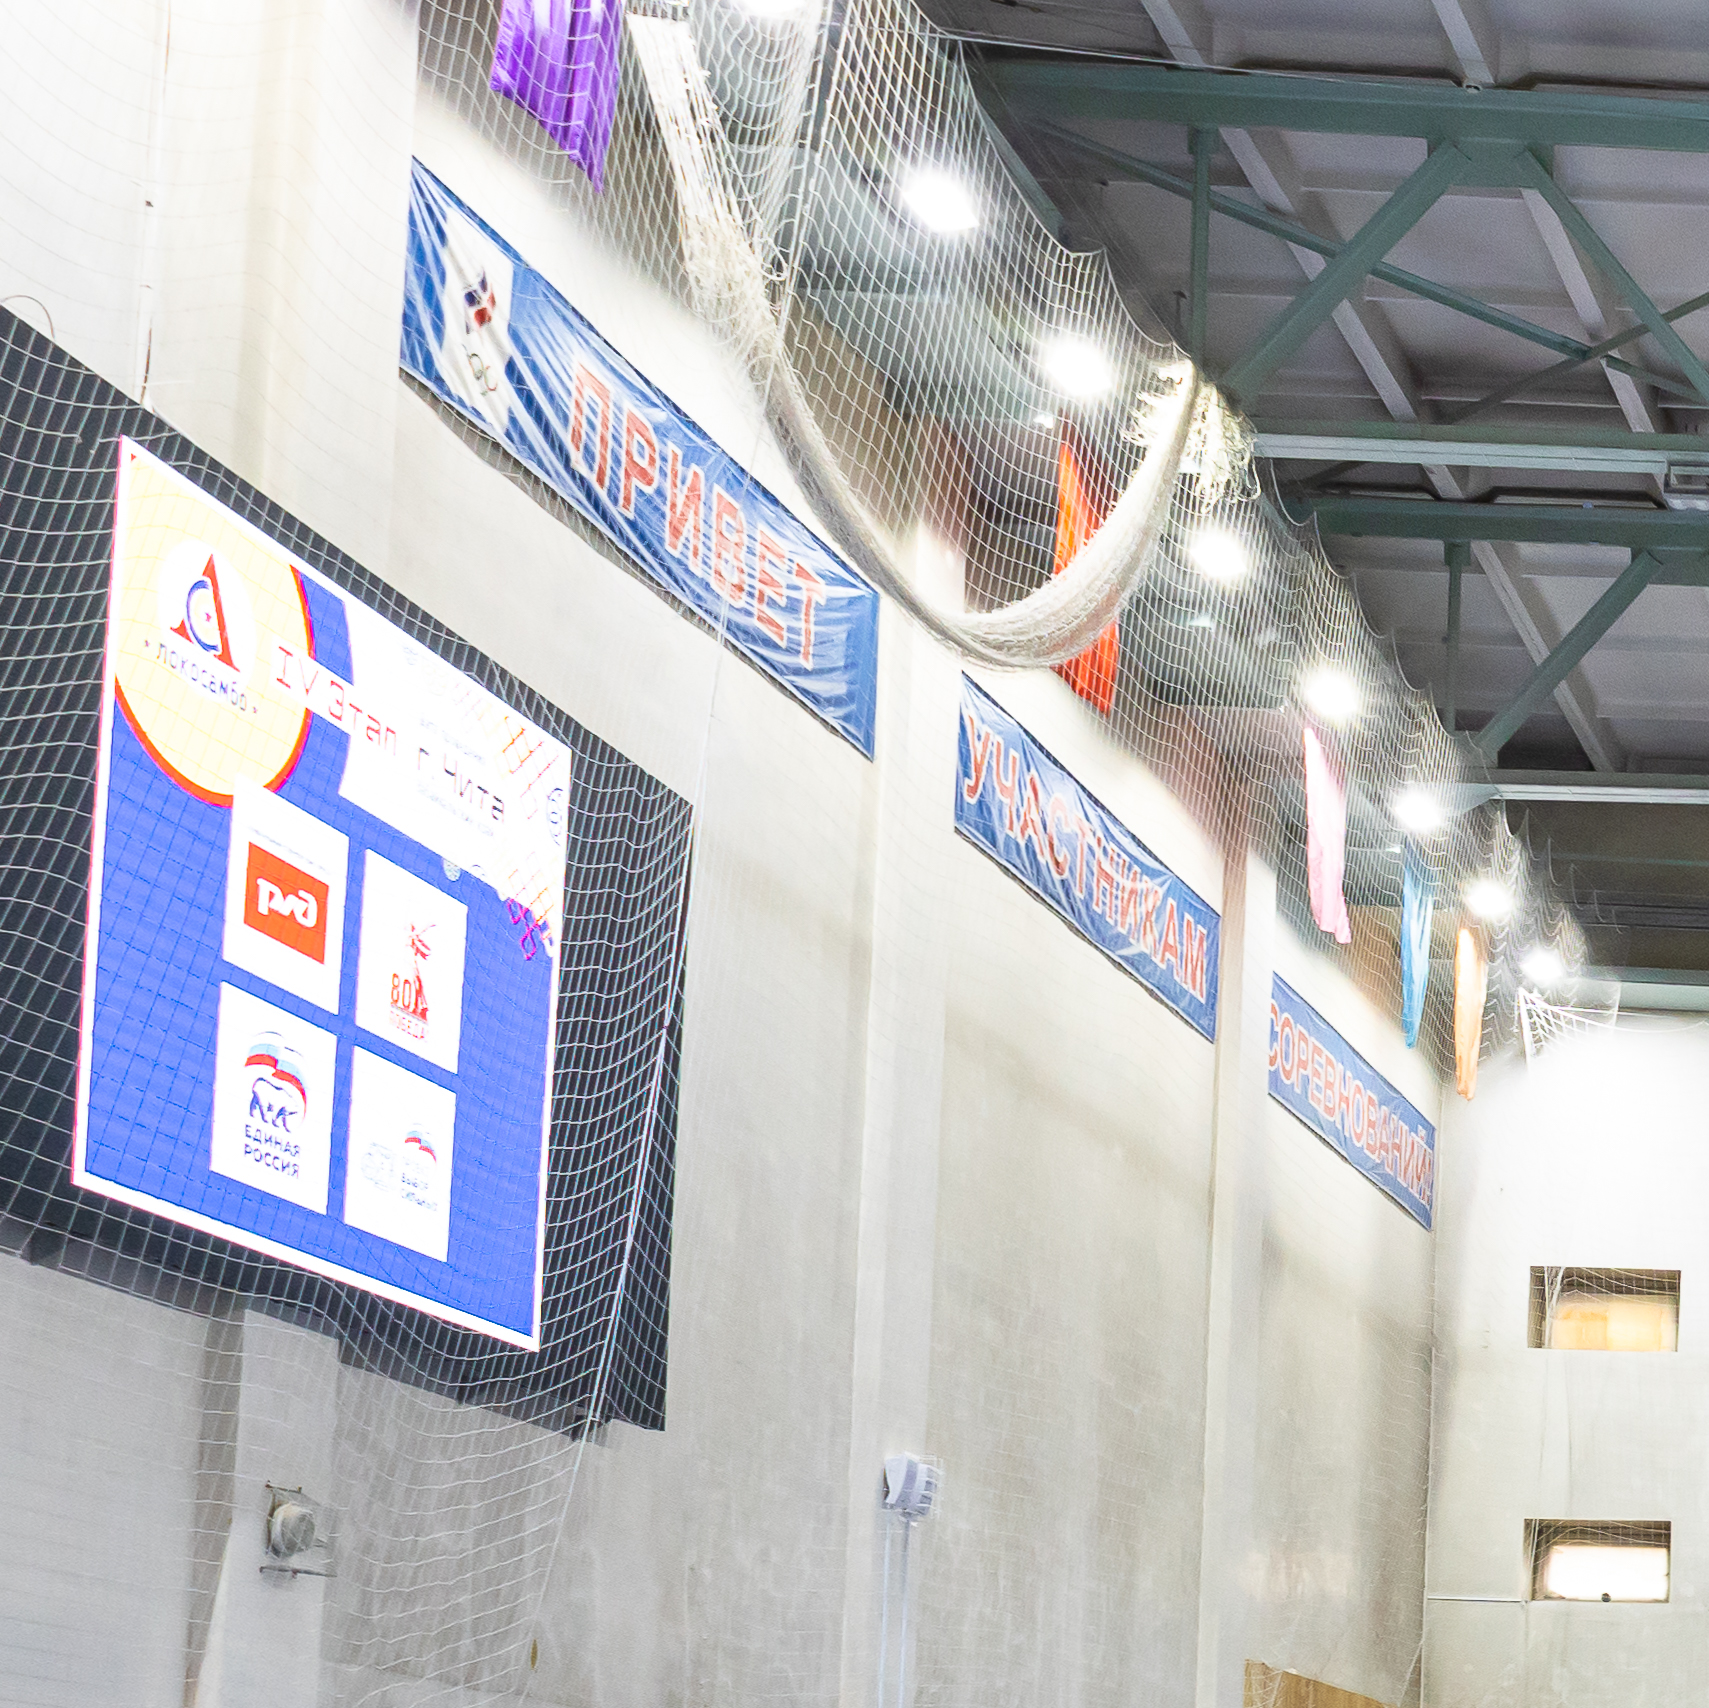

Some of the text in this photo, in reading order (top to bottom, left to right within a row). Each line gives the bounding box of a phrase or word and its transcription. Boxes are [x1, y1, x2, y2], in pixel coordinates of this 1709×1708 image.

[570, 362, 826, 669] ПРИВЕТ
[964, 709, 1207, 1005] УЧАСТНИКАМ
[244, 1143, 299, 1179] РОССИЯ
[245, 1124, 300, 1157] ЕДИНАЯ
